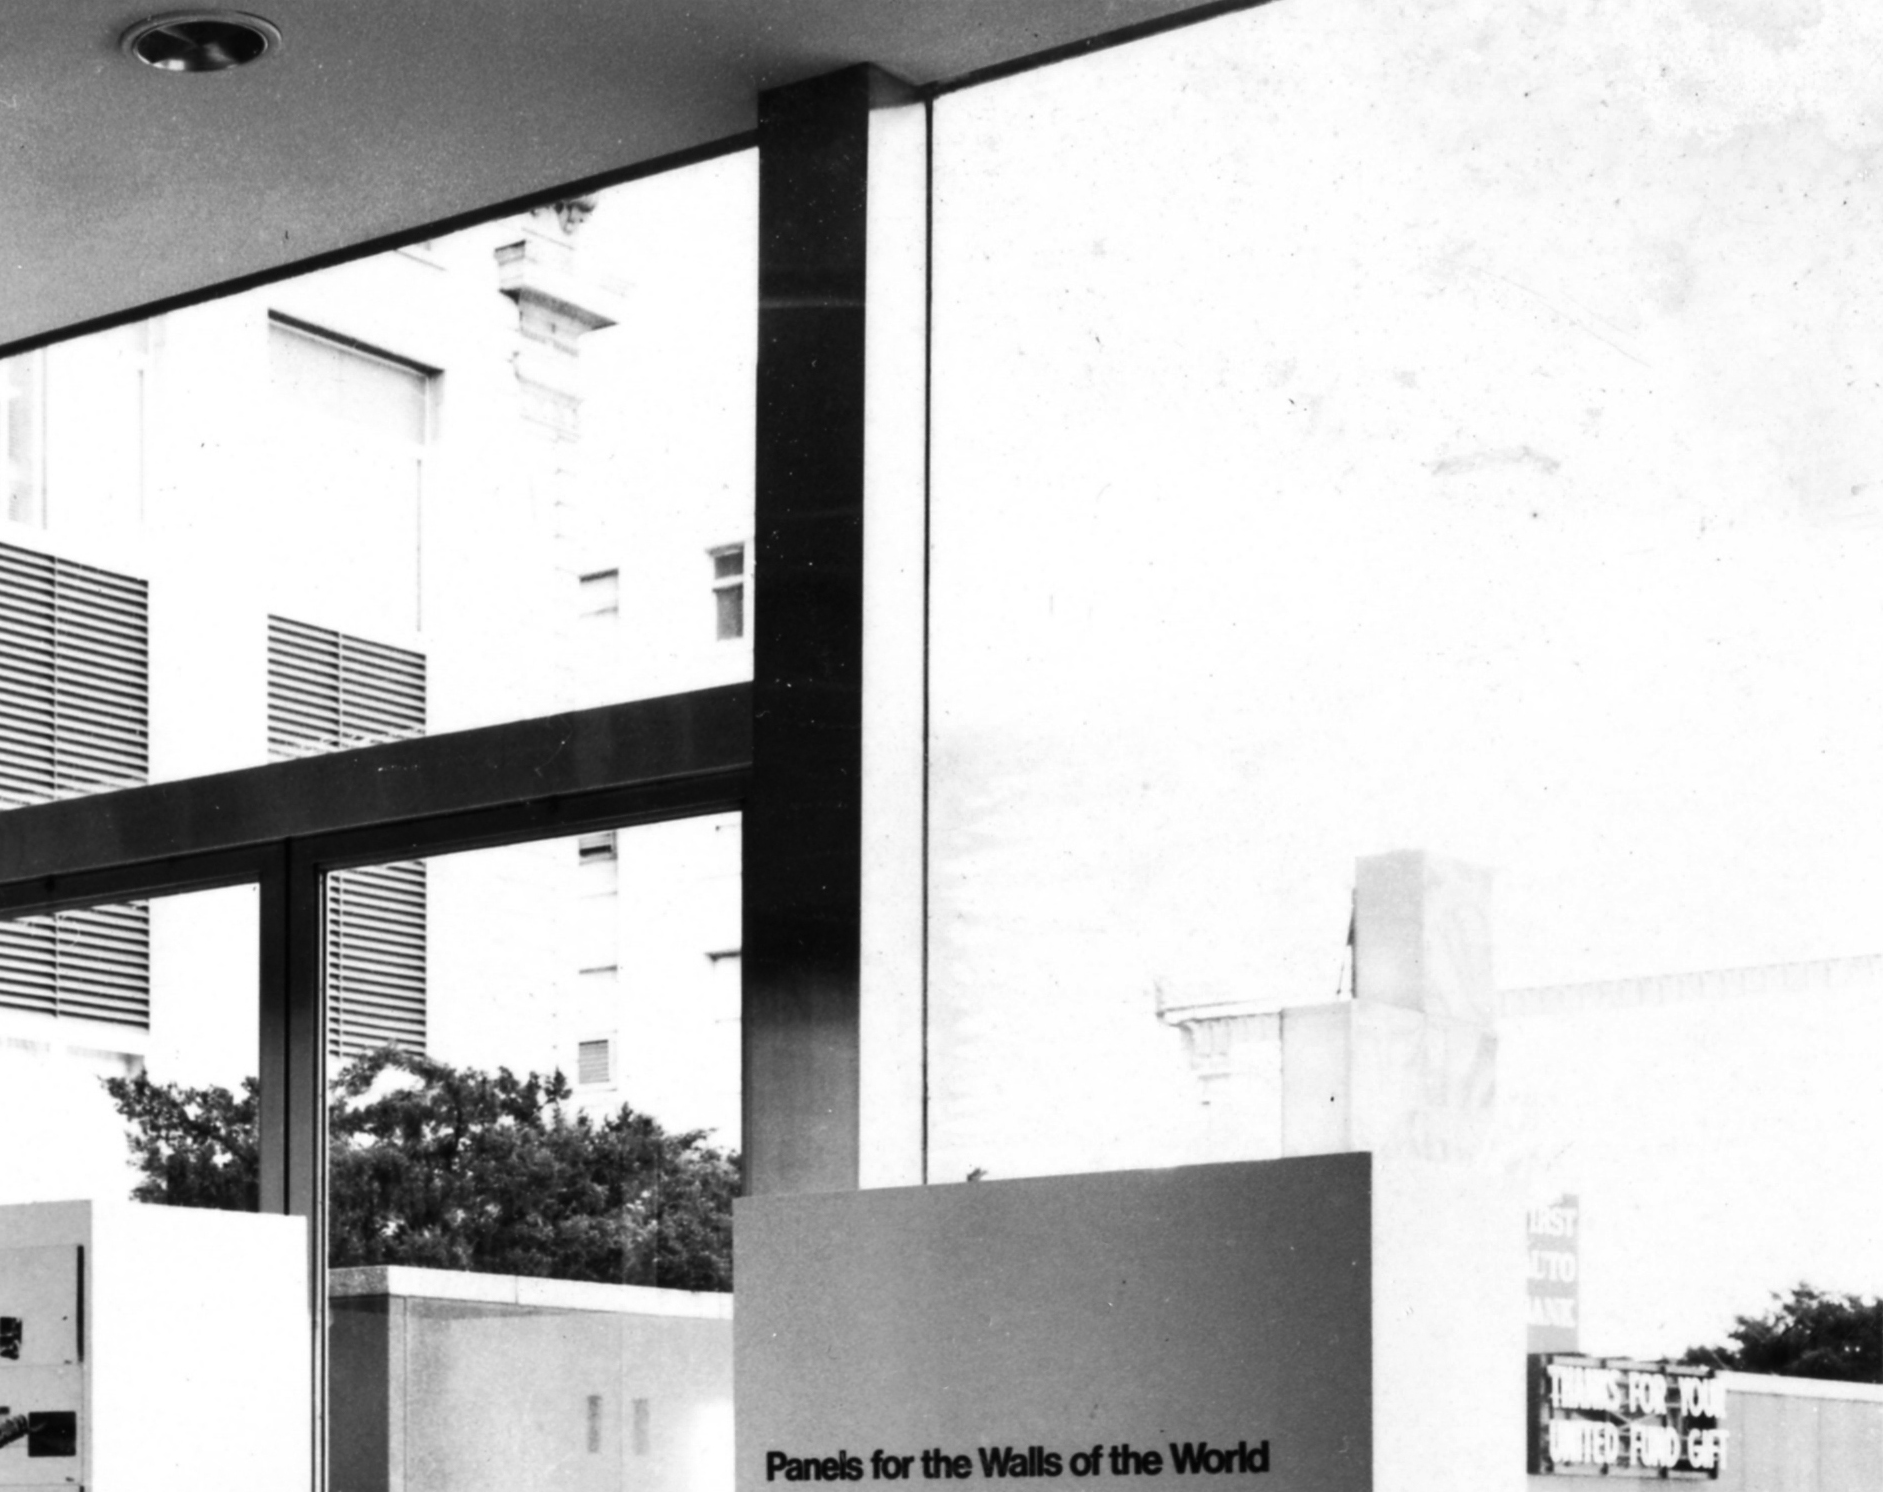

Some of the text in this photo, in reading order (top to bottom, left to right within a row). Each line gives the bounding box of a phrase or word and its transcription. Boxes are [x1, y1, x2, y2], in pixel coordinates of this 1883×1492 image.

[1527, 1207, 1576, 1237] IRST
[1527, 1250, 1576, 1283] UTO
[1527, 1297, 1576, 1327] ANK
[1547, 1365, 1726, 1419] THANKS FOR YOUR
[766, 1439, 1271, 1482] Panels for the Walls of the World
[1548, 1419, 1730, 1469] UNITED FUND GIFT
